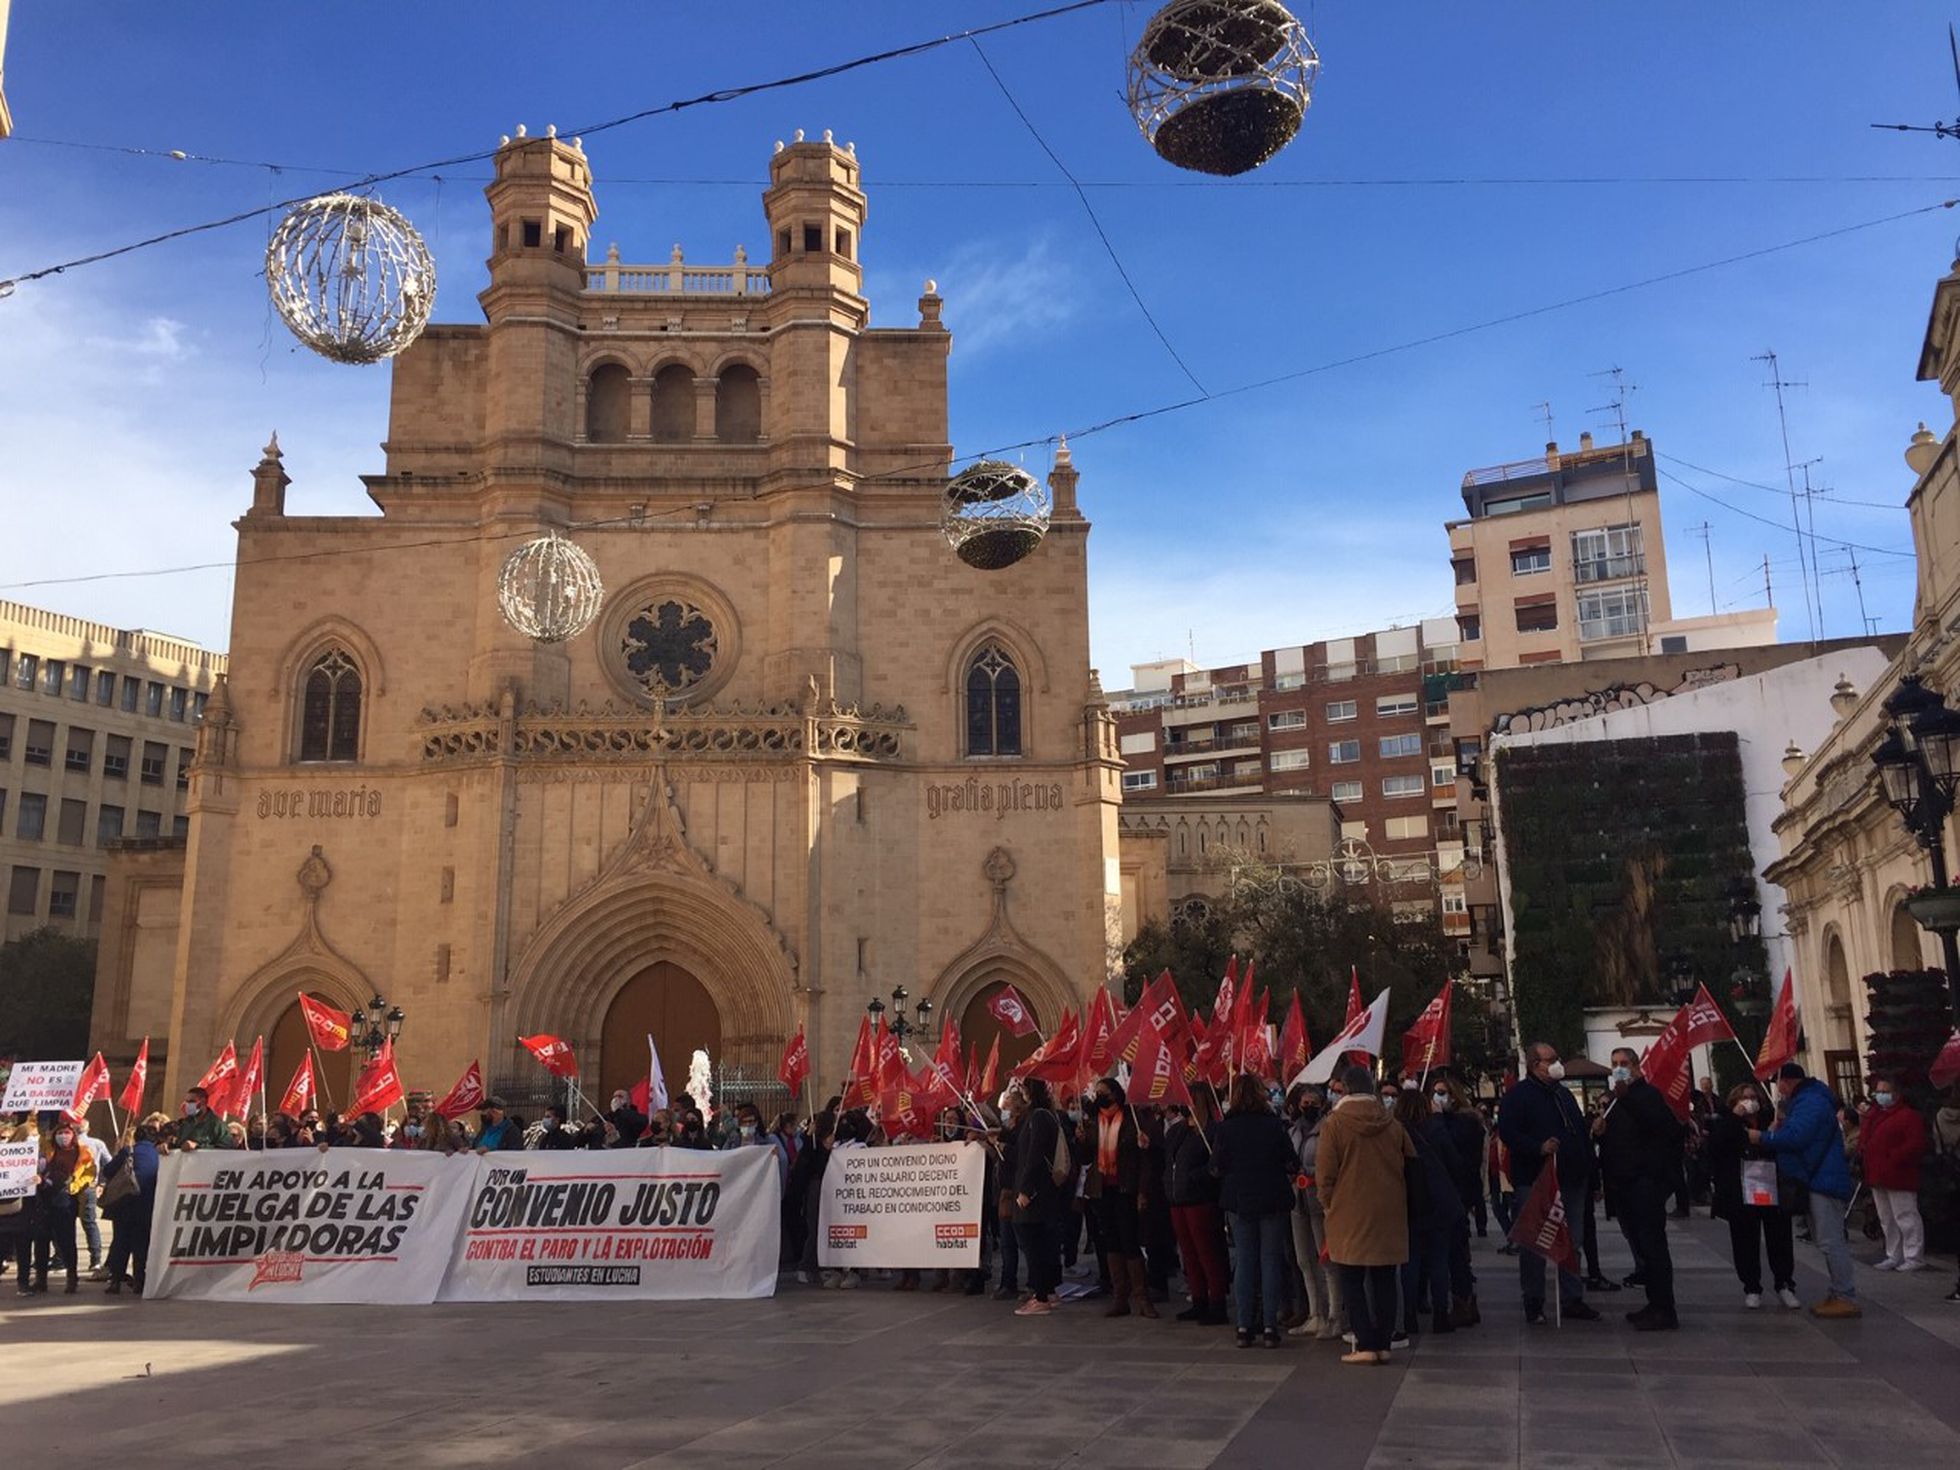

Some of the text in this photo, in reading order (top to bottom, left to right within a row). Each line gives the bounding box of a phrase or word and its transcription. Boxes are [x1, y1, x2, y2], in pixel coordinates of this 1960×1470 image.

[21, 1064, 77, 1073] MI MADRE
[26, 1076, 62, 1085] NO ES
[13, 1089, 73, 1098] LA BASURA
[7, 1099, 70, 1108] QUE LIMPIA
[0, 1147, 34, 1157] OMOS
[847, 1153, 957, 1169] POR UN CONVENIO DIGNO
[212, 1170, 384, 1191] EN APOYO A LA
[486, 1168, 528, 1186] POR UN
[845, 1170, 958, 1184] POR UN SALARIO DECENTE
[836, 1185, 968, 1199] POR EL RECONOCIMIENTO DEL
[173, 1193, 419, 1222] HUELGA DE LAS
[470, 1182, 720, 1228] CONVENIO JUSTO
[843, 1201, 961, 1214] TRABAJO EN CONDICIONES
[937, 1227, 964, 1236] CCOO
[466, 1234, 714, 1260] CONTRA EL PARO Y LA EXPLOTACIÓN
[529, 1267, 639, 1283] ESTUDIANTES EN LUCHA
